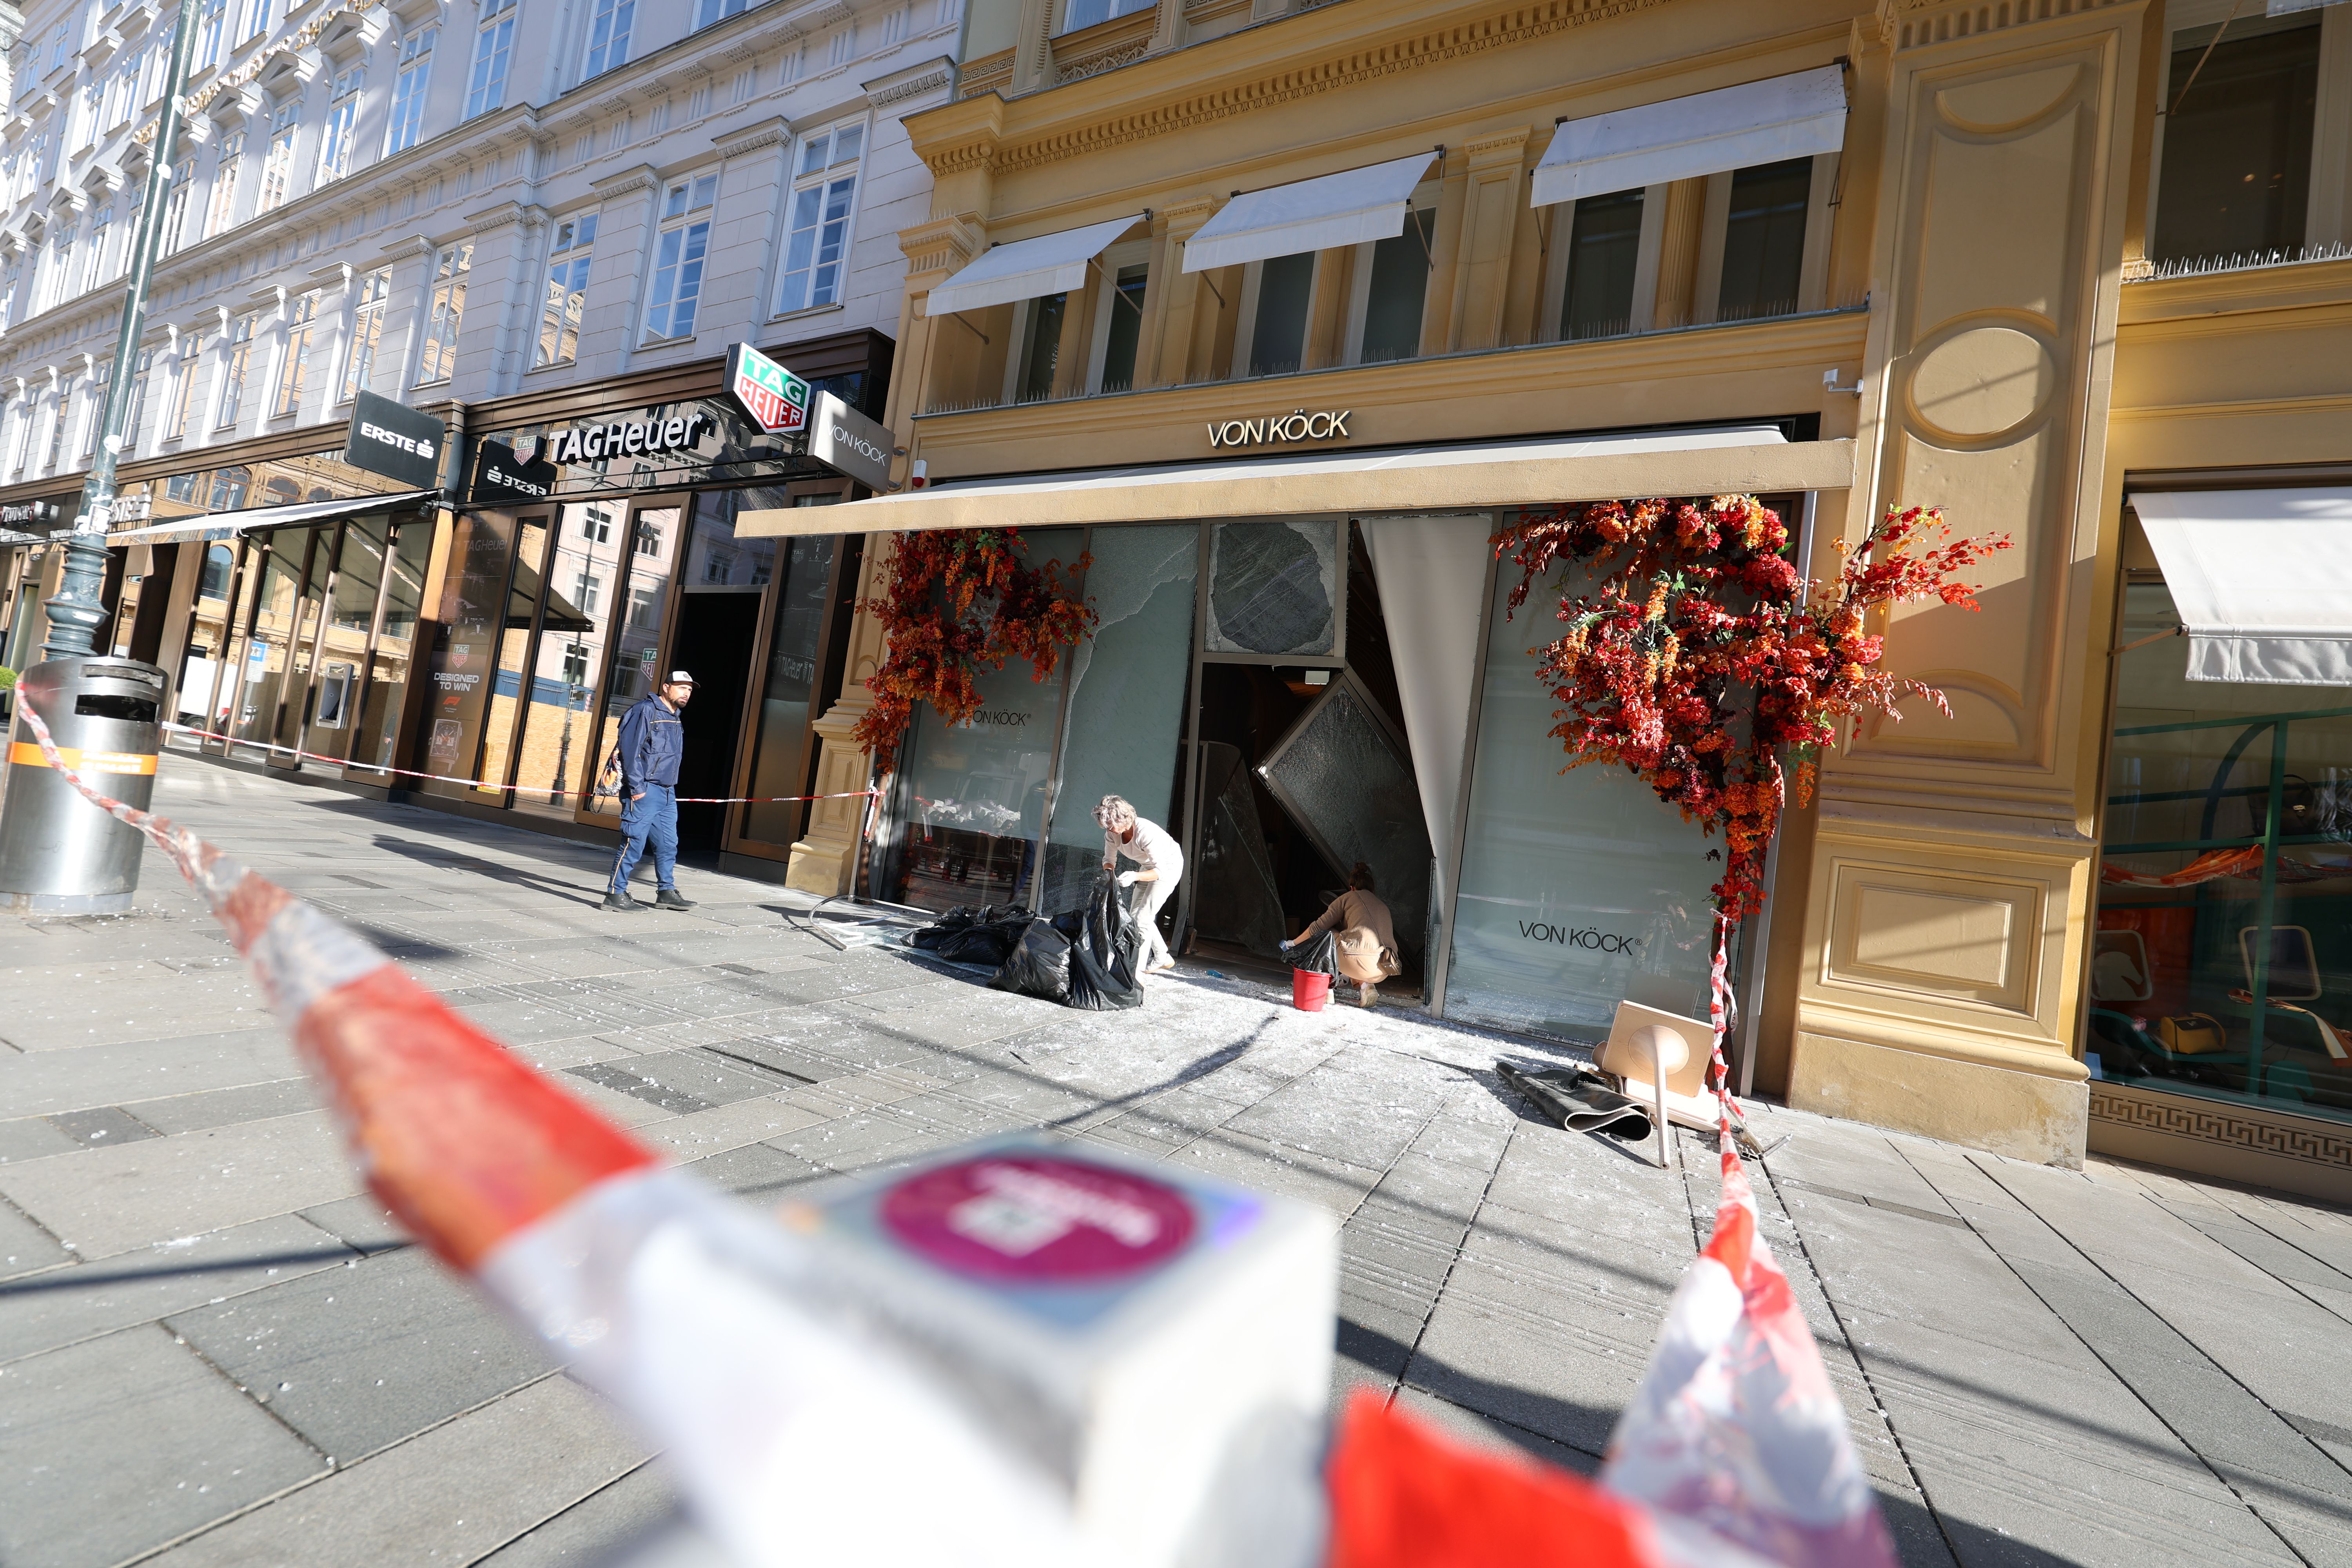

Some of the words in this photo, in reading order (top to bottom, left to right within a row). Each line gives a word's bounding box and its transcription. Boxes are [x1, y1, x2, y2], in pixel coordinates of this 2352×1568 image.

[748, 354, 802, 404] TAG
[742, 379, 800, 426] HEUER
[1207, 419, 1265, 448] VON
[1269, 409, 1351, 443] KÖCK
[360, 422, 416, 453] ERSTE
[518, 438, 534, 448] TAG
[827, 420, 853, 447] VON
[854, 437, 886, 466] KÖCK
[515, 449, 533, 462] HEUER
[453, 655, 466, 666] HEUER
[645, 651, 657, 660] TA
[434, 672, 479, 683] DESIGNED
[642, 663, 655, 678] HEU
[439, 681, 452, 690] TO
[454, 682, 471, 692] WIN
[972, 710, 992, 724] ON
[1519, 920, 1566, 944] VON
